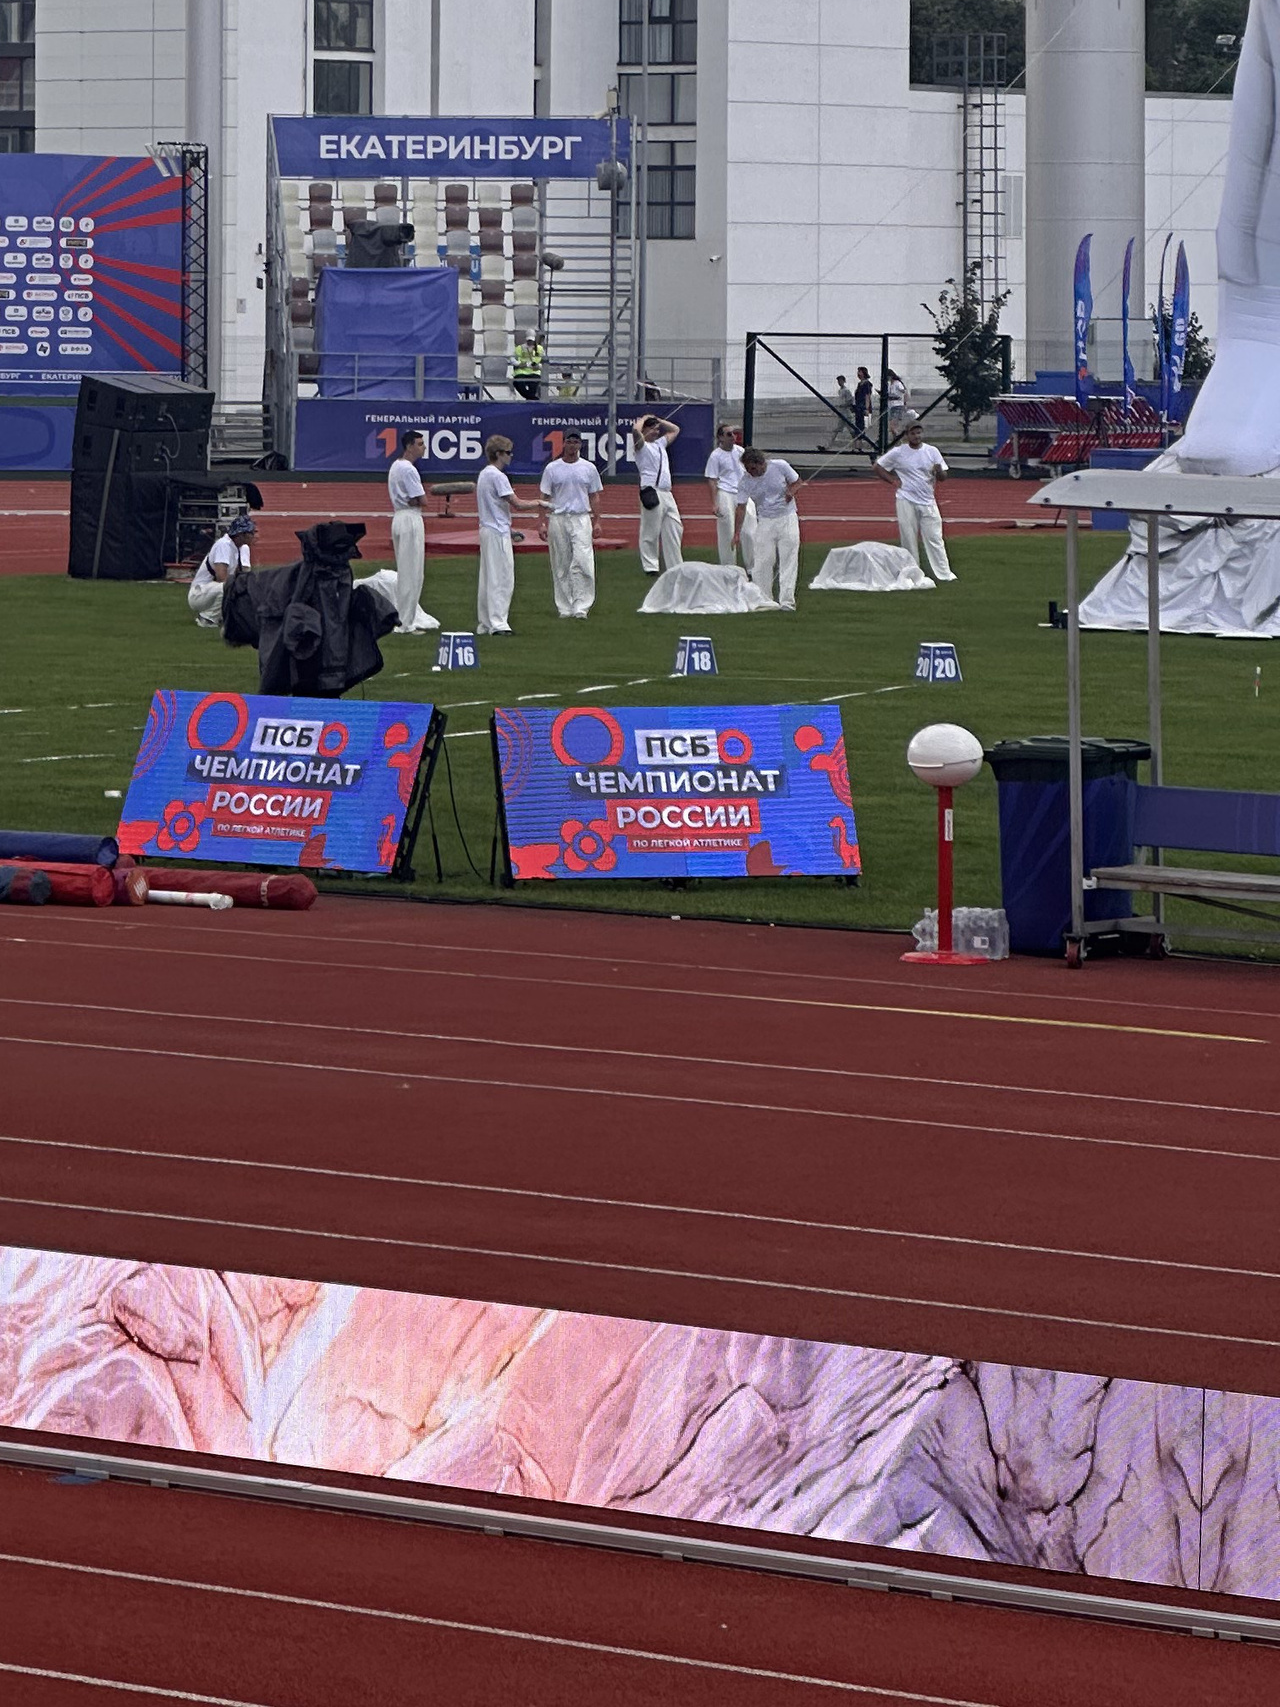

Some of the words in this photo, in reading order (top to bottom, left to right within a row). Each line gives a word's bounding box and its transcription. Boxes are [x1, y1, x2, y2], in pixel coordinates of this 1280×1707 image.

[319, 135, 582, 161] ЕКАТЕРИНБУРГ
[365, 414, 435, 424] ГЕНЕРАЛЬНЫЙ
[438, 415, 482, 424] ПАРТНЁР
[532, 416, 602, 426] ГЕНЕРАЛЬНЫЙ
[455, 646, 475, 666] 16
[691, 651, 712, 671] 18
[916, 657, 930, 677] 20
[934, 657, 956, 678] 20
[260, 725, 314, 748] ПСБ
[646, 736, 710, 757] ПСБ
[194, 755, 361, 786] ЧЕМПИОНАТ
[575, 770, 780, 793] ЧЕМПИОНАТ
[211, 791, 323, 818] РОССИИ
[617, 805, 751, 829] РОССИИ
[633, 839, 649, 848] ПО
